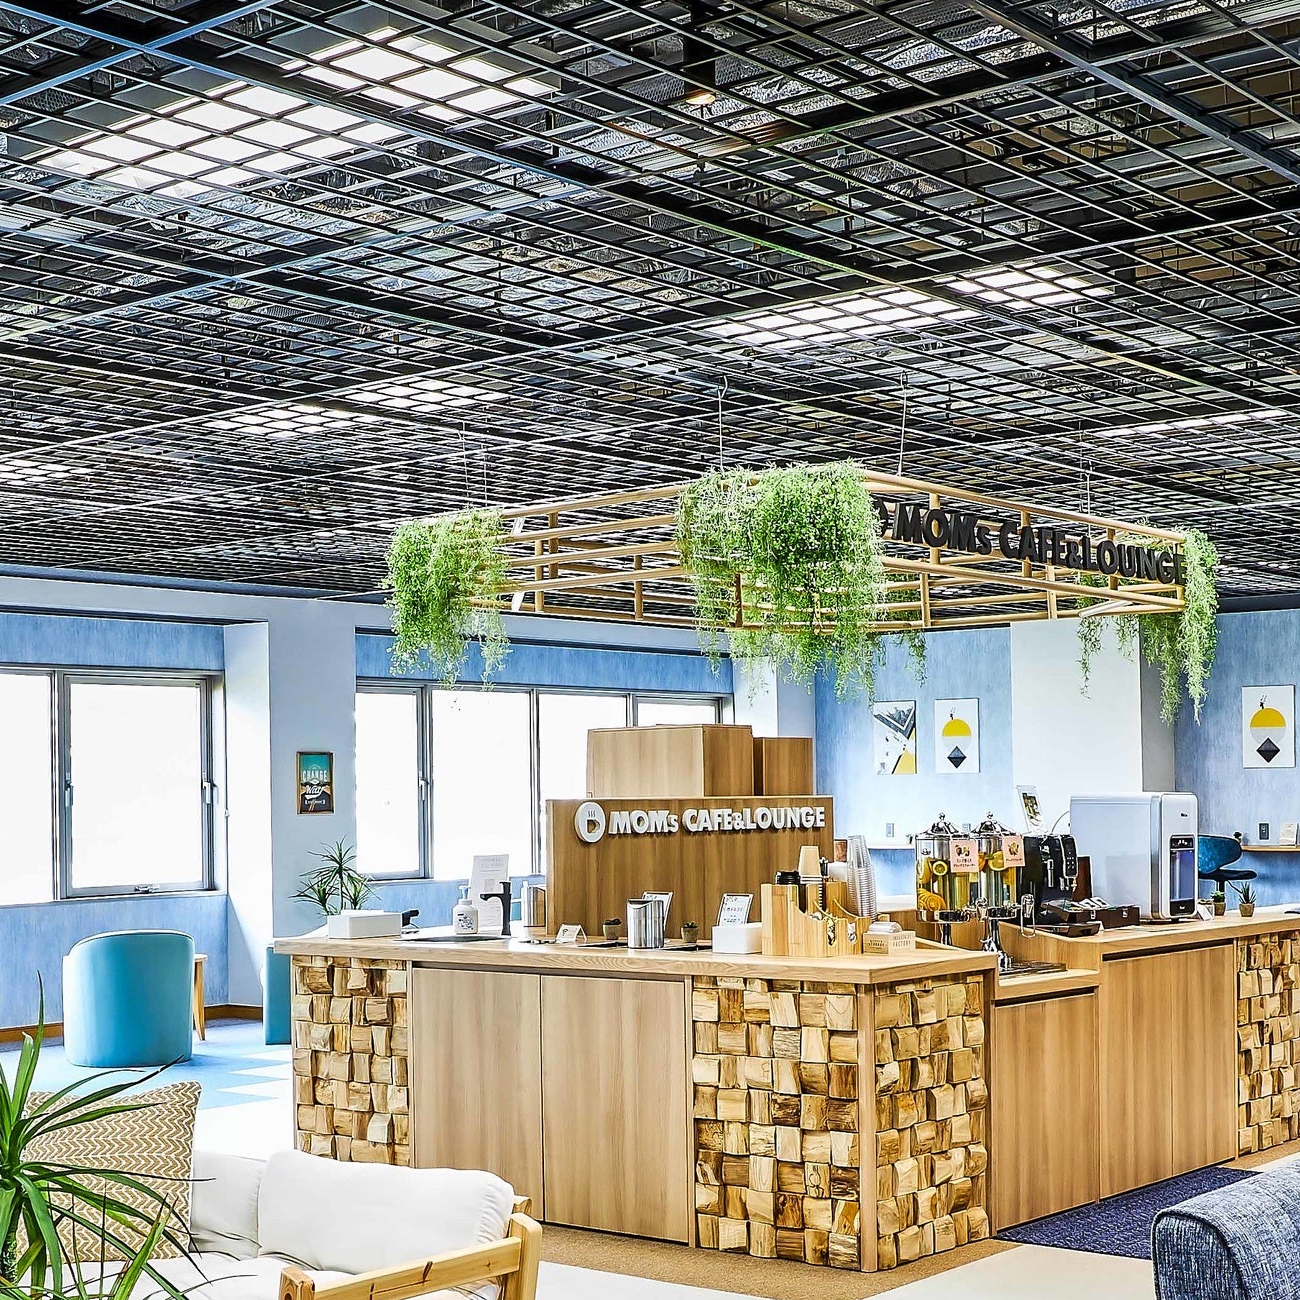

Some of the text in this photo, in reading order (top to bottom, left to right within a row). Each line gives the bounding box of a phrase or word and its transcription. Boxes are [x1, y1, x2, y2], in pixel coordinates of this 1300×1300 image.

[893, 503, 1187, 586] MOMs CAFE&LOUNGE
[608, 806, 825, 835] MOMs CAFE&LOUNGE
